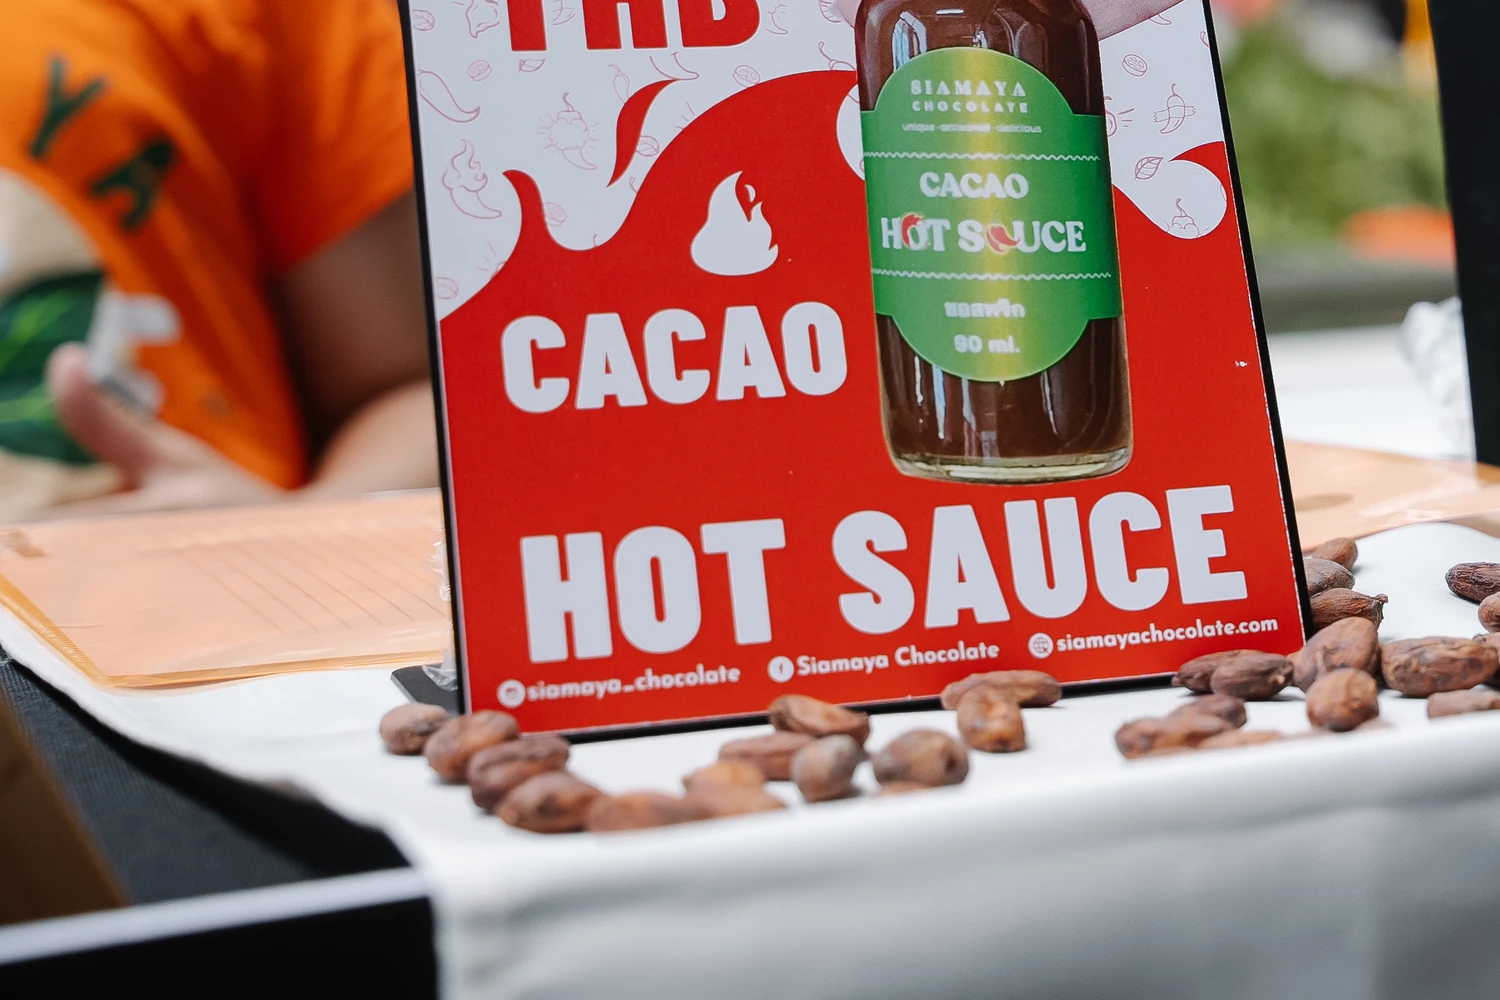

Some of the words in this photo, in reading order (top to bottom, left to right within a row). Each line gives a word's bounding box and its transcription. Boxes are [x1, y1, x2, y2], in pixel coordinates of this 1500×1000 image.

[910, 79, 1027, 97] SIAMAYA
[912, 100, 1028, 113] CHOCOLATE
[919, 172, 1029, 199] CACAO
[881, 212, 950, 252] HOT
[502, 301, 847, 413] CACAO
[954, 335, 982, 353] 90
[988, 335, 1020, 353] ml.
[520, 518, 786, 663] HOT
[832, 485, 1248, 634] SAUCE
[1057, 617, 1278, 652] siamayachocolate.com
[797, 654, 889, 676] Siamaya
[894, 640, 1000, 668] Chocolate
[525, 664, 741, 700] siamaya_chocolate
